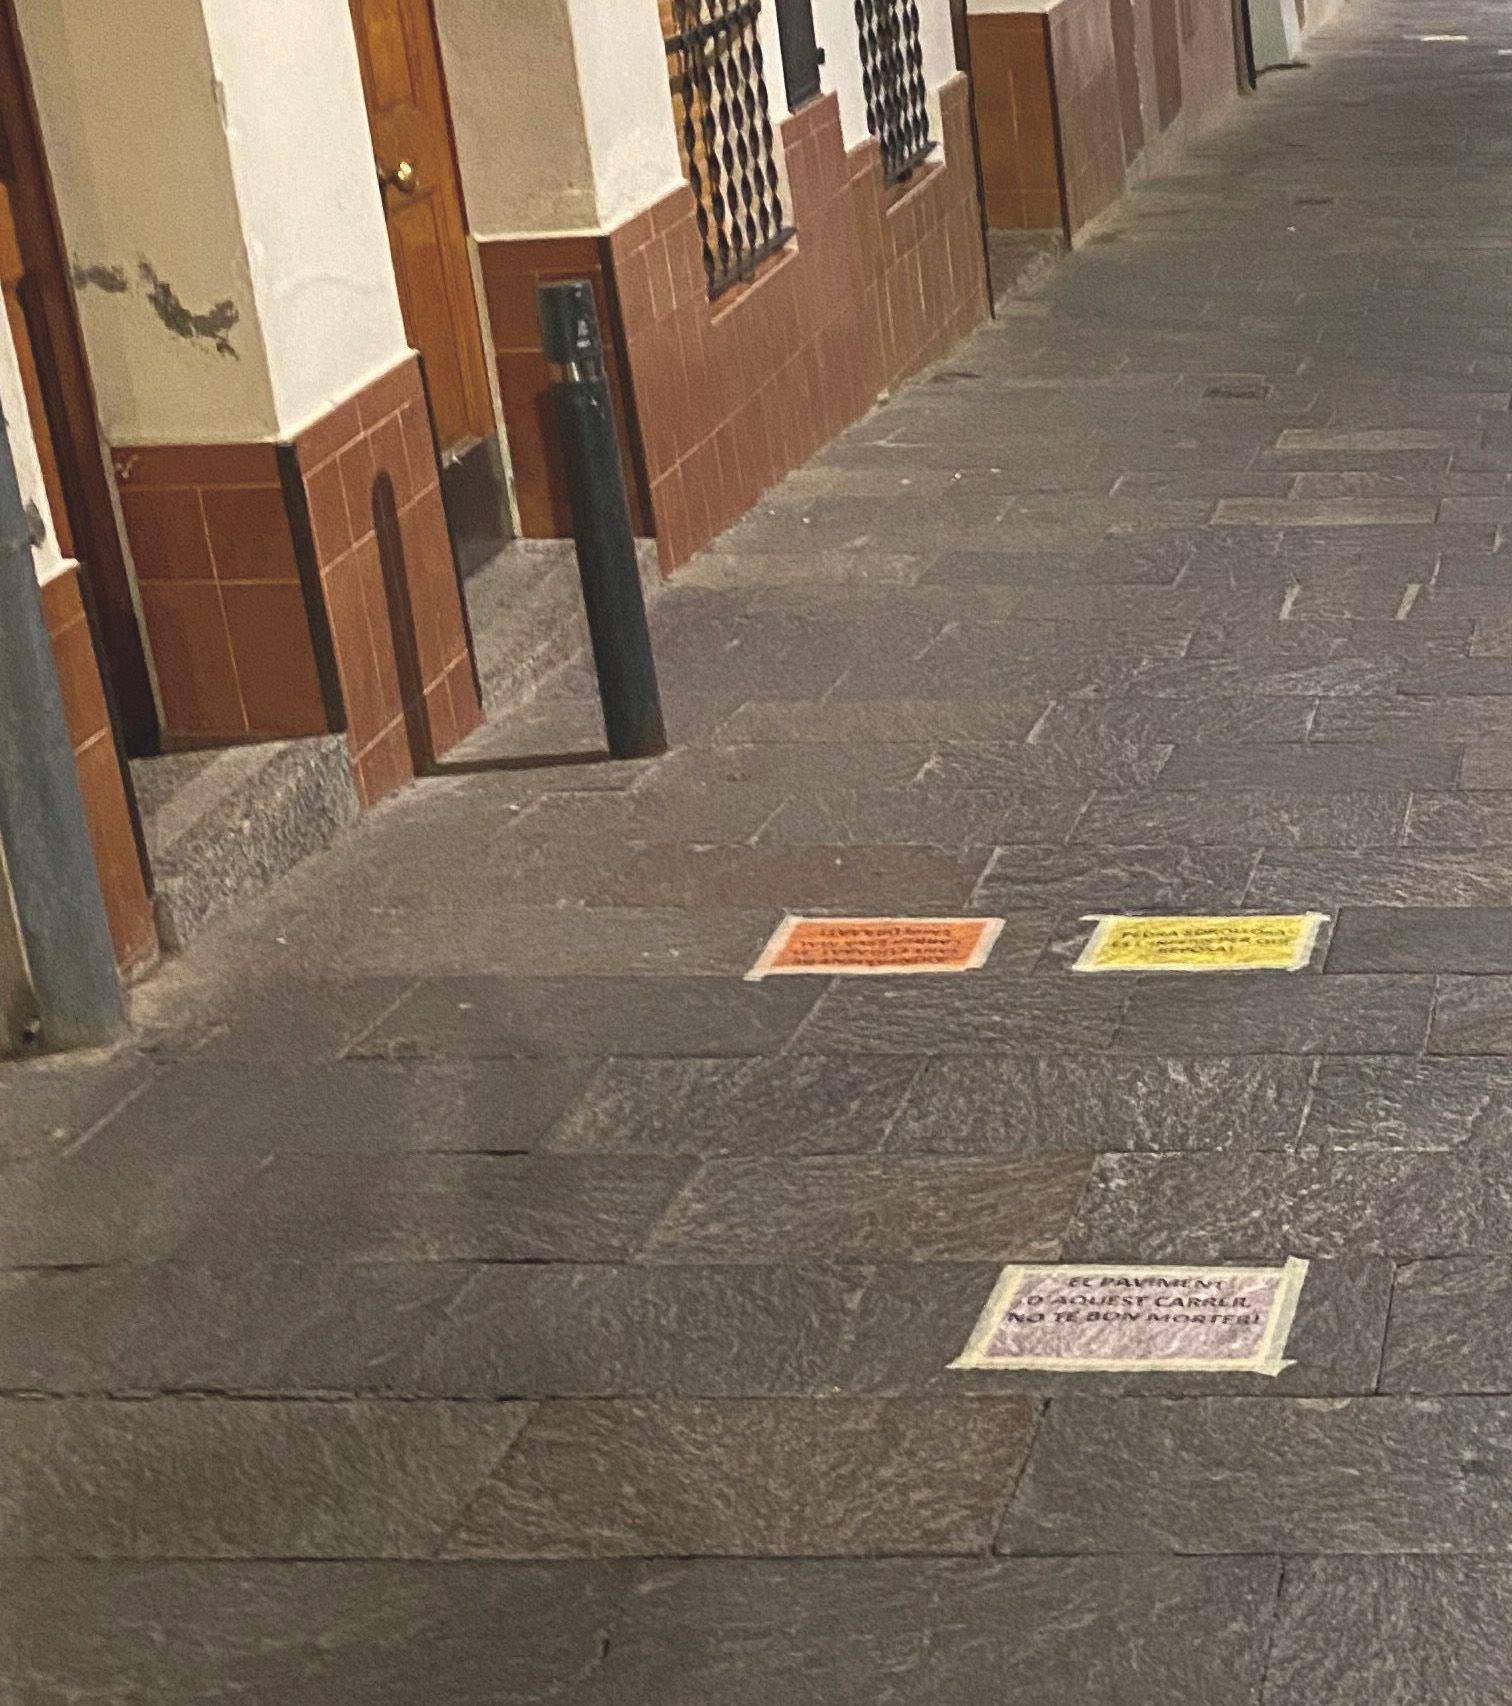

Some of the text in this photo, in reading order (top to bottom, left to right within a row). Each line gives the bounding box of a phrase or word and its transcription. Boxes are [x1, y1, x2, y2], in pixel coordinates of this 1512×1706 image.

[1068, 1276, 1228, 1290] EL PAVIMENT
[1006, 1311, 1045, 1324] NO
[1086, 1311, 1144, 1323] BON
